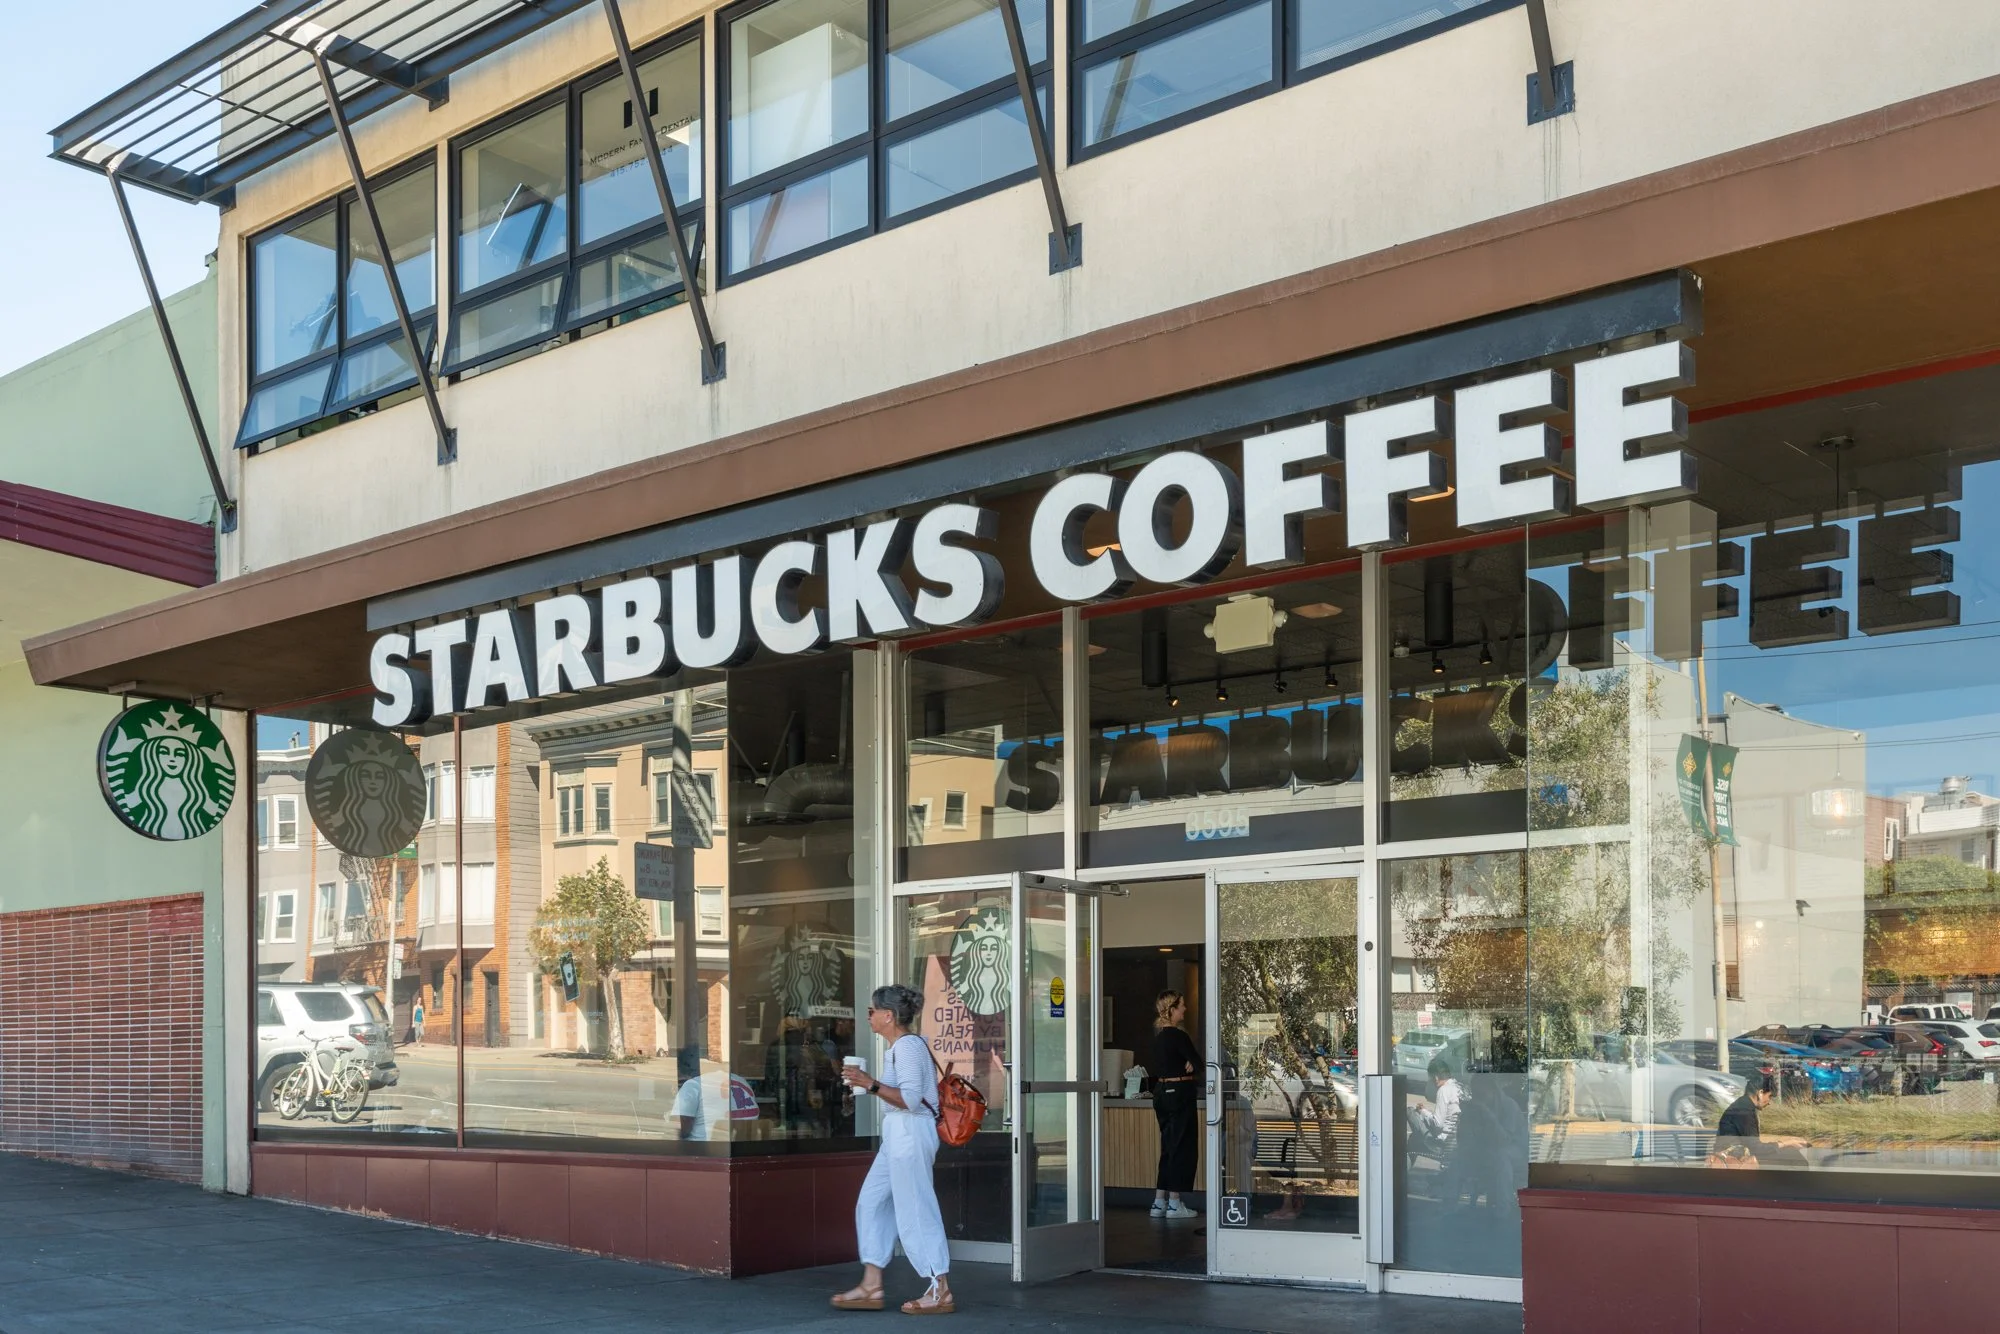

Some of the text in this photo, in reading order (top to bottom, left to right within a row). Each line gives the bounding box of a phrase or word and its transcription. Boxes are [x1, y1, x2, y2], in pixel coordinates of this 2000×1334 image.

[589, 144, 626, 165] MODERN
[661, 115, 695, 134] DENTAL
[370, 339, 1684, 727] STARBUCKS COFFEE
[1185, 808, 1249, 841] 3595
